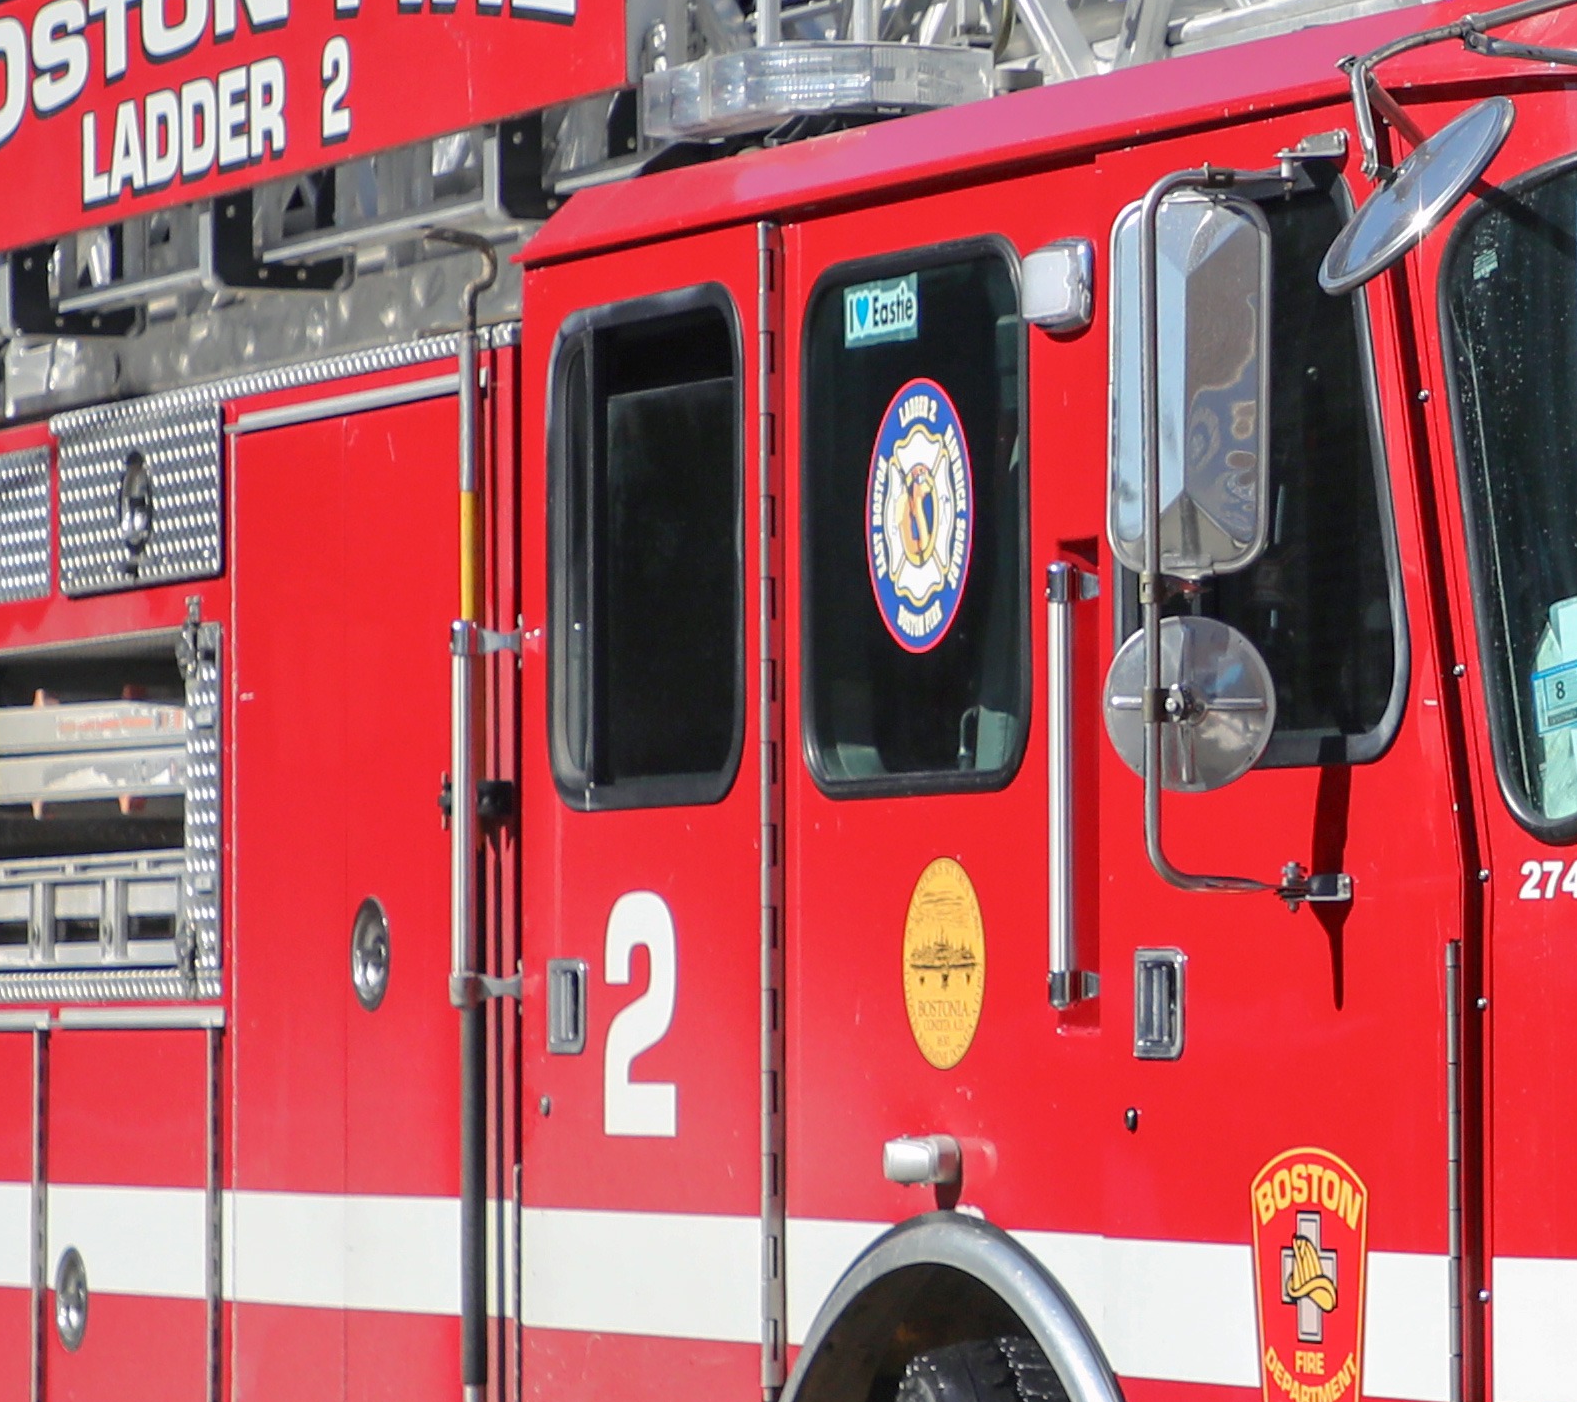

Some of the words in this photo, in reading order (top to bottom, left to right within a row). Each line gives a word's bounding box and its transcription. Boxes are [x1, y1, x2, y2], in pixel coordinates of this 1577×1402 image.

[83, 57, 287, 210] LADDER
[322, 36, 352, 145] 2
[873, 289, 914, 327] Eastie
[1555, 680, 1566, 700] 8
[604, 890, 678, 1138] 2
[1255, 1163, 1362, 1231] BOSTON
[1294, 1350, 1326, 1375] FIRE
